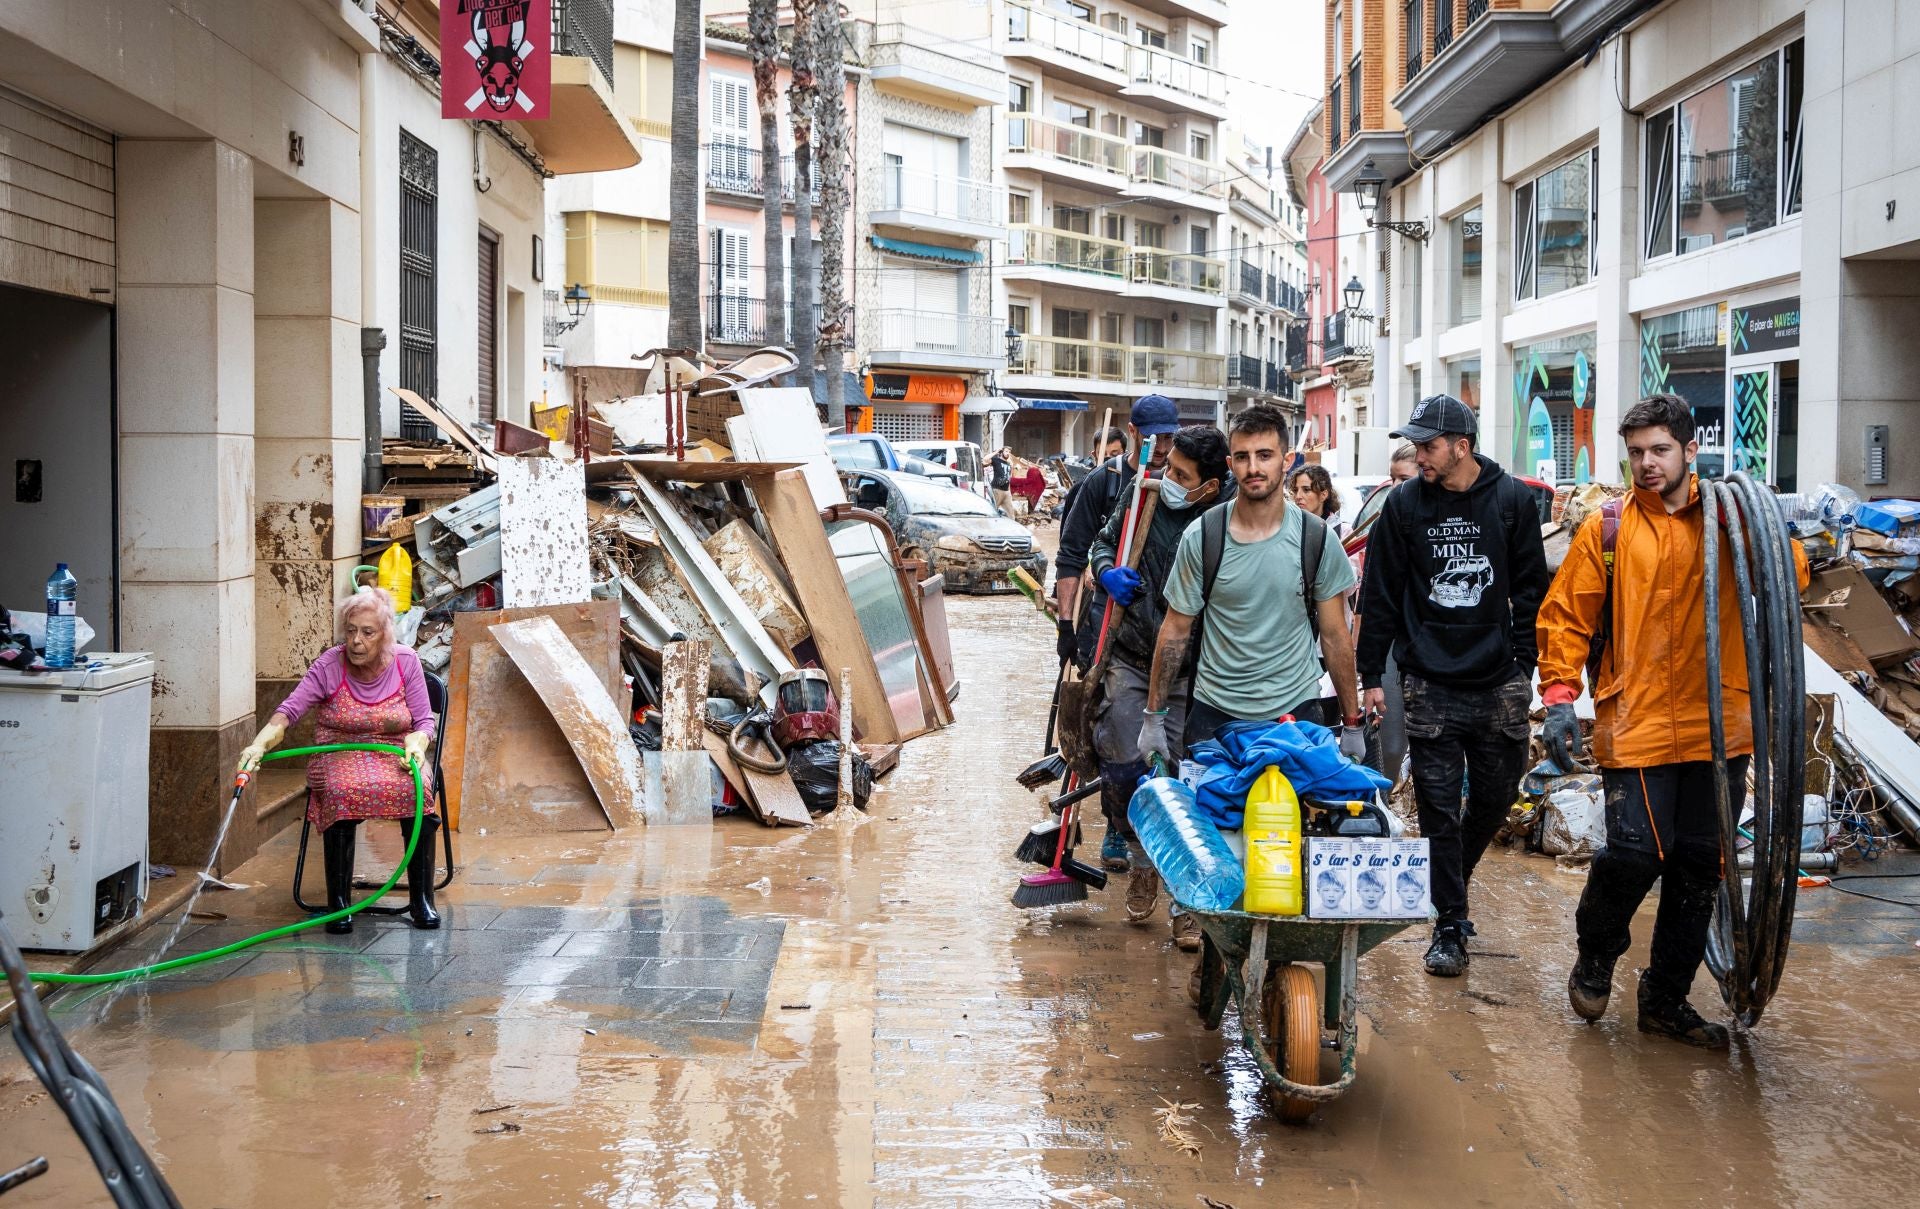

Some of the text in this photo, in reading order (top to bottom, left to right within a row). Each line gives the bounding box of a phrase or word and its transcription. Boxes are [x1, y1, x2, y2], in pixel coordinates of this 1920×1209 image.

[485, 9, 504, 30] per
[1767, 316, 1773, 329] de
[913, 381, 956, 397] VISTALIA
[1694, 419, 1721, 453] net
[1427, 525, 1481, 537] OLD MAN
[1432, 542, 1475, 558] MINI
